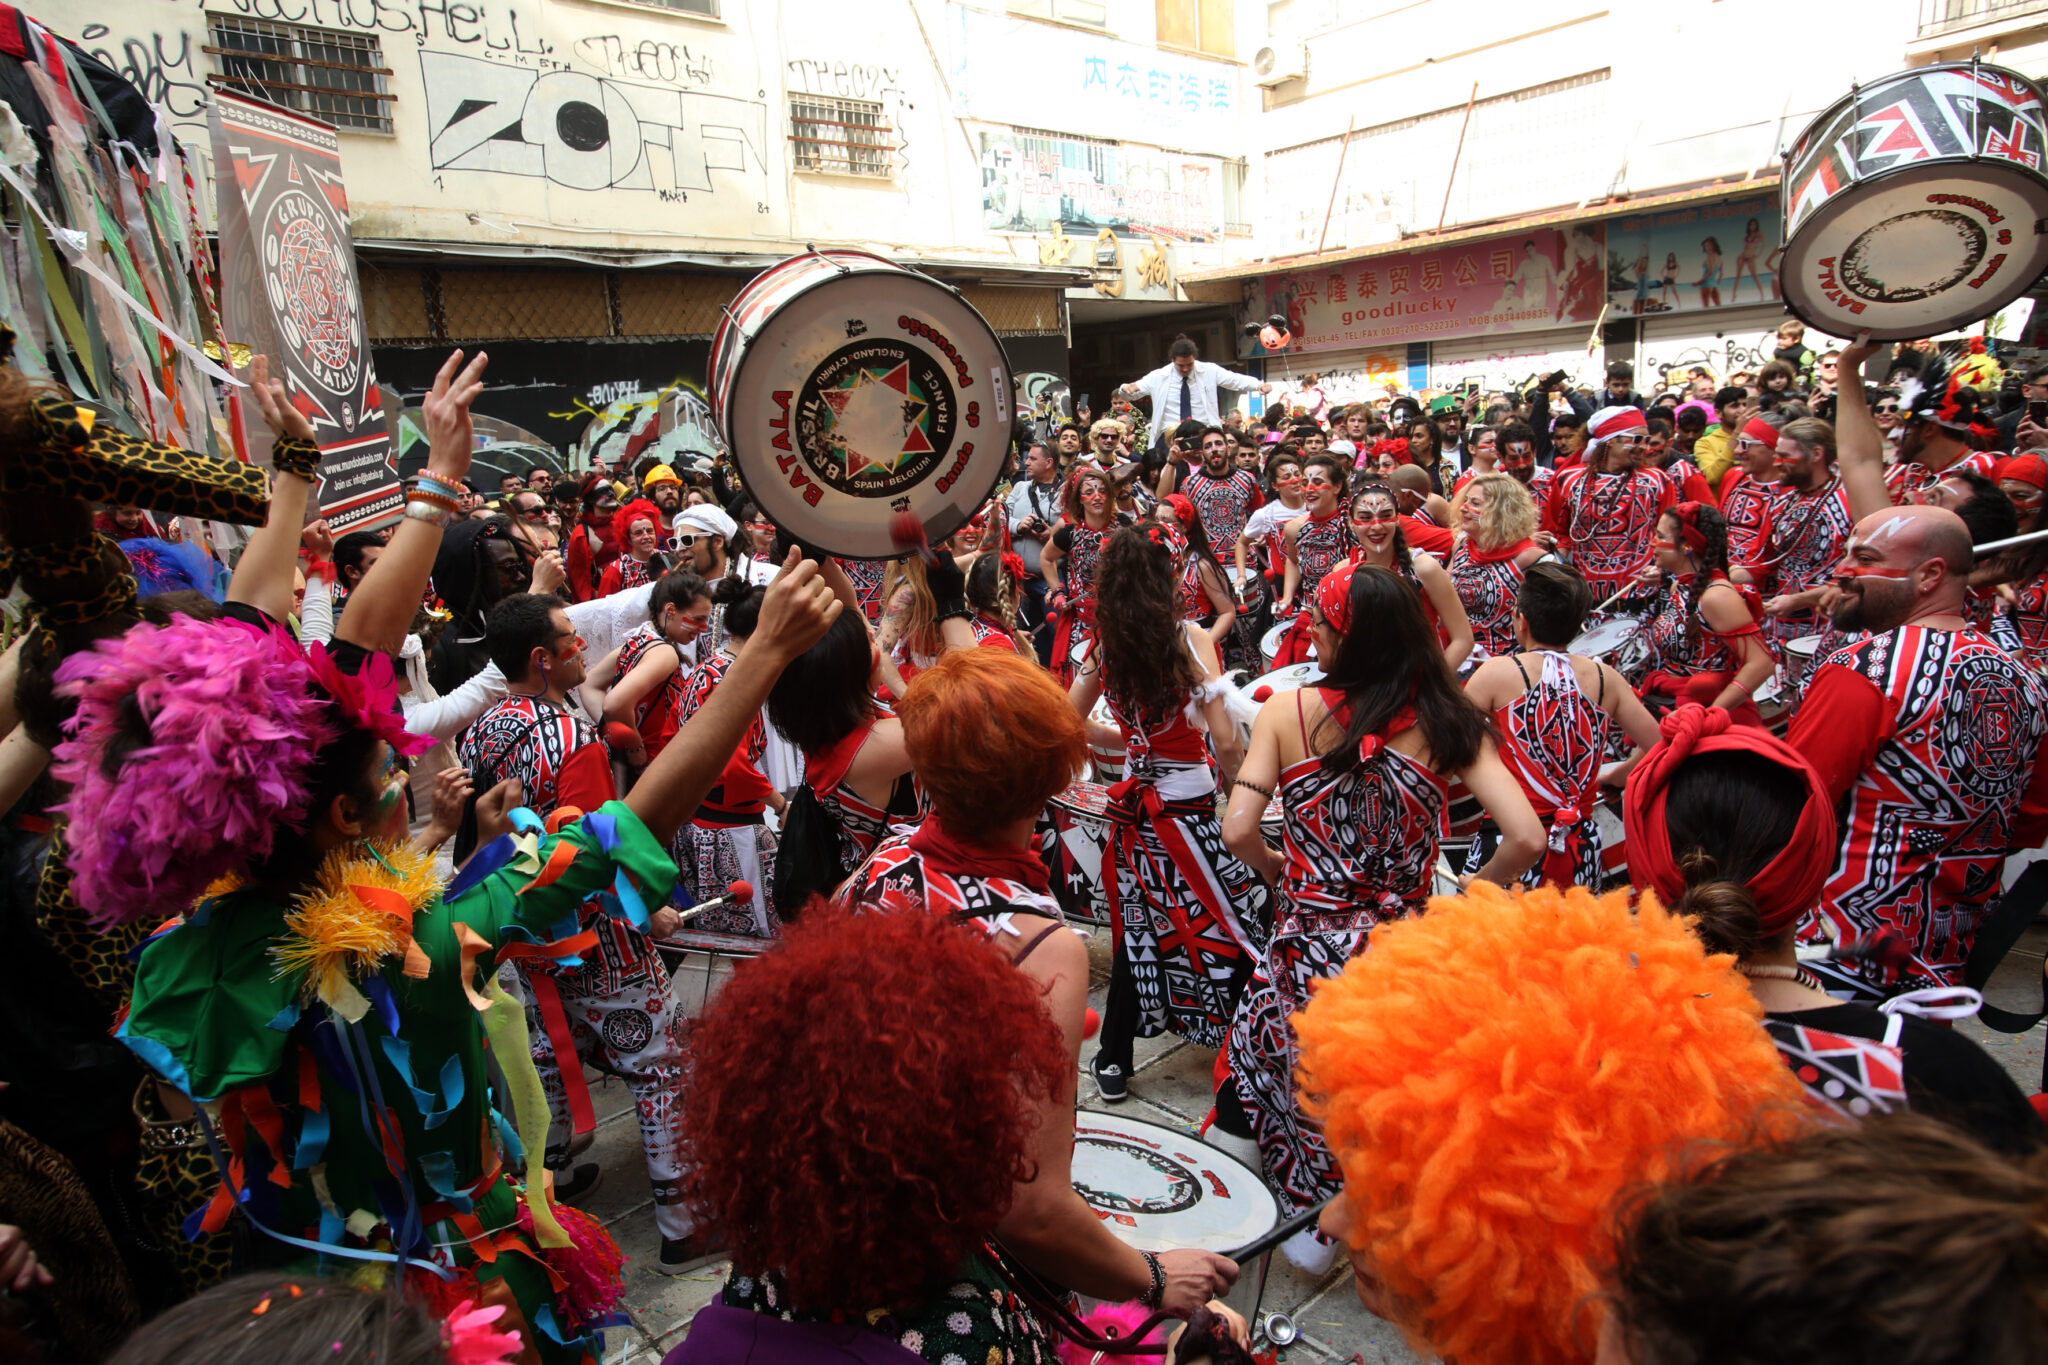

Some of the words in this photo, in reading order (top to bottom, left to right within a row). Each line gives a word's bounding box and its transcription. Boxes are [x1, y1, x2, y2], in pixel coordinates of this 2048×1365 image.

[1022, 150, 1062, 174] H&F
[278, 198, 326, 232] GRUPO
[1296, 249, 1516, 306] 兴隆泰贸易公司
[1818, 256, 1868, 315] BATALA
[1341, 296, 1458, 326] goodlucky
[854, 348, 905, 360] ENGLAND
[897, 314, 973, 388] Percussão
[313, 358, 358, 390] BATALA
[817, 357, 849, 385] CYMRU
[922, 370, 948, 434] FRANCE
[965, 401, 980, 428] de
[769, 390, 825, 508] BATALA
[801, 398, 841, 481] BRASIL
[324, 452, 384, 475] www.mundobatala.com
[853, 480, 885, 490] SPAIN
[888, 456, 931, 486] BELGIUM
[935, 442, 974, 494] Banda
[1962, 658, 2014, 681] GRUPO
